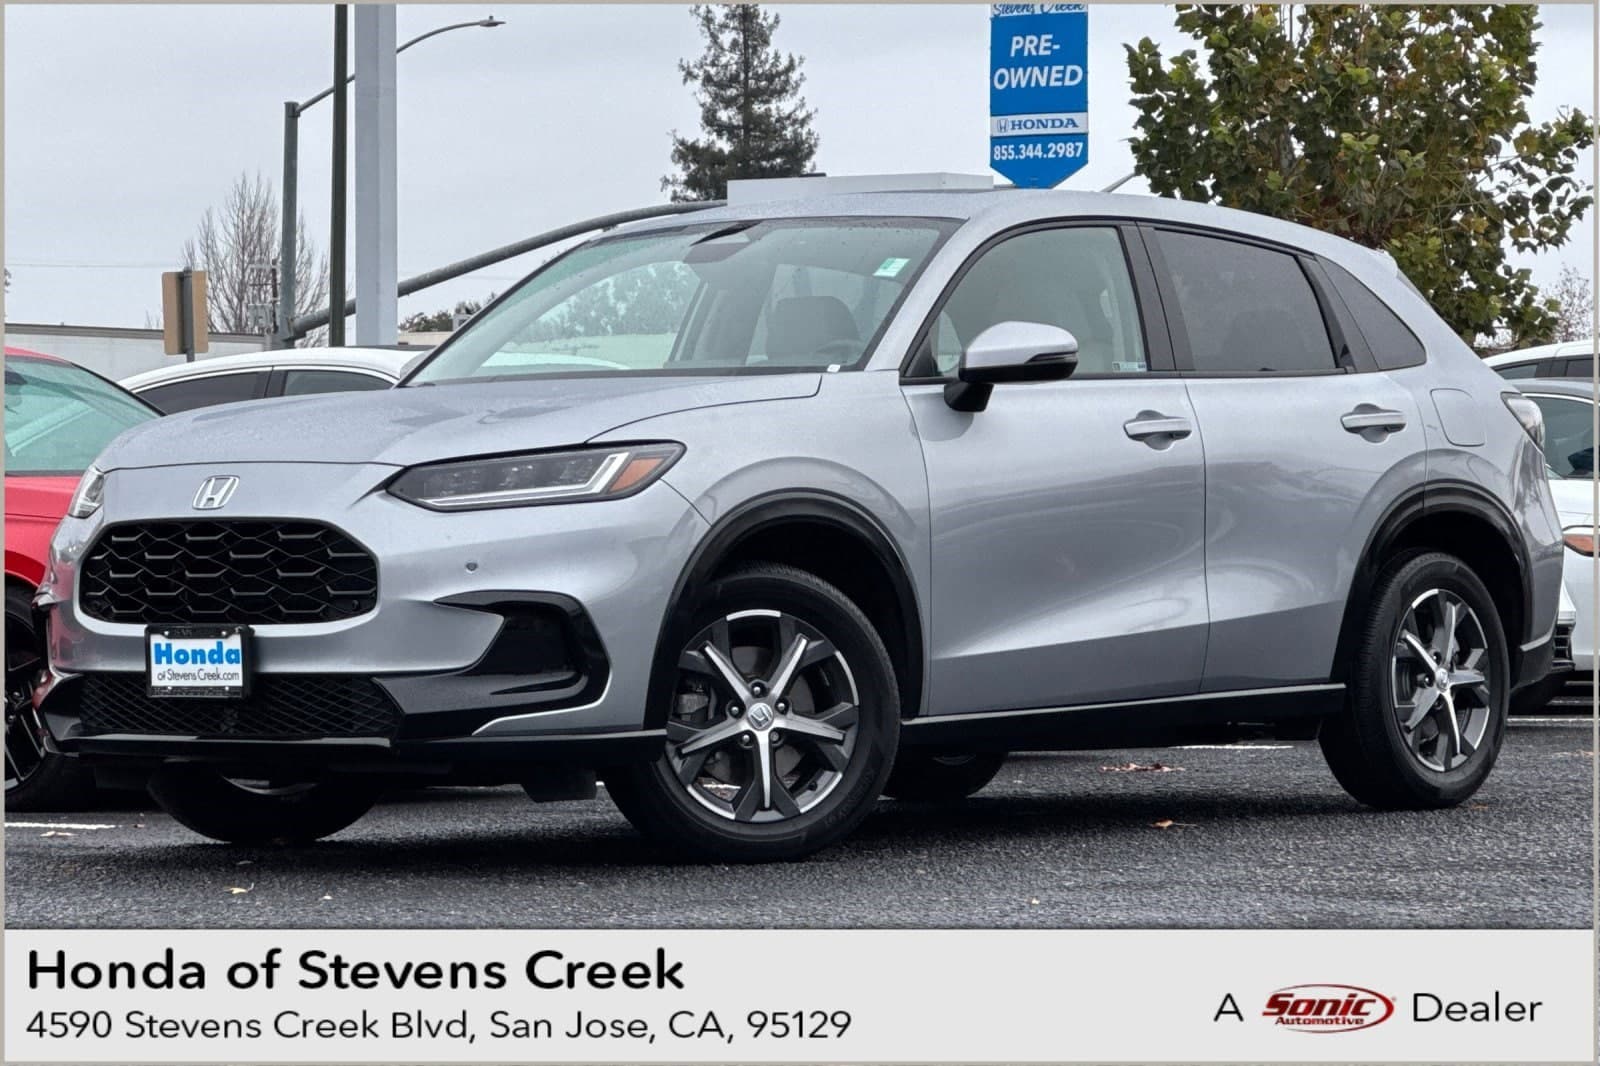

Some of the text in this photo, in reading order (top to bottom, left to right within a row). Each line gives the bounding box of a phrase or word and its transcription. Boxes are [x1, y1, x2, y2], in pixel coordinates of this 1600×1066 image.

[1010, 34, 1060, 57] PRE-
[993, 65, 1083, 90] OWNED
[1011, 118, 1079, 131] HONDA
[993, 142, 1083, 160] 855.344.2987
[154, 641, 241, 665] Honda
[167, 668, 197, 681] Stevens
[197, 667, 240, 681] Creek.com
